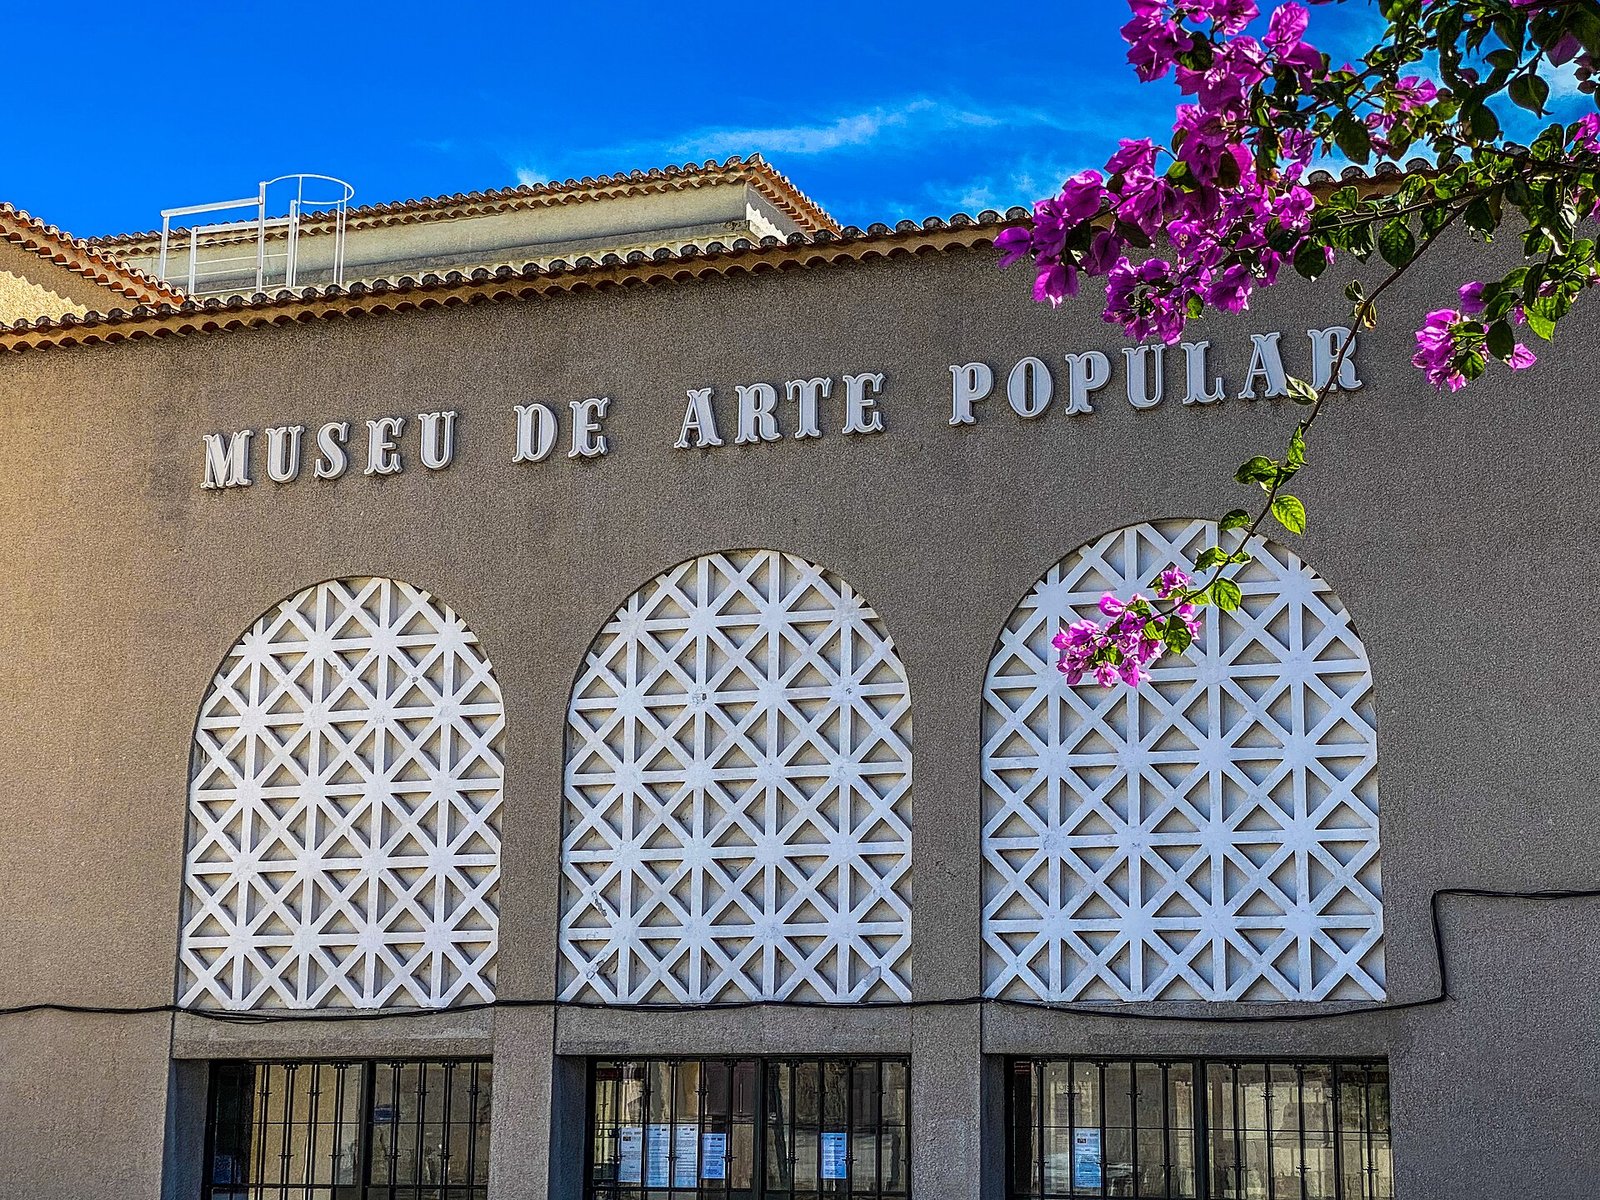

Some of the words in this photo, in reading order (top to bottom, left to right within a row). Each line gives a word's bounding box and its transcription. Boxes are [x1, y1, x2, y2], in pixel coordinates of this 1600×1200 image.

[200, 411, 459, 489] MUSEU
[512, 396, 611, 463] DE
[673, 372, 886, 449] ARTE
[949, 326, 1363, 427] POPULAR
